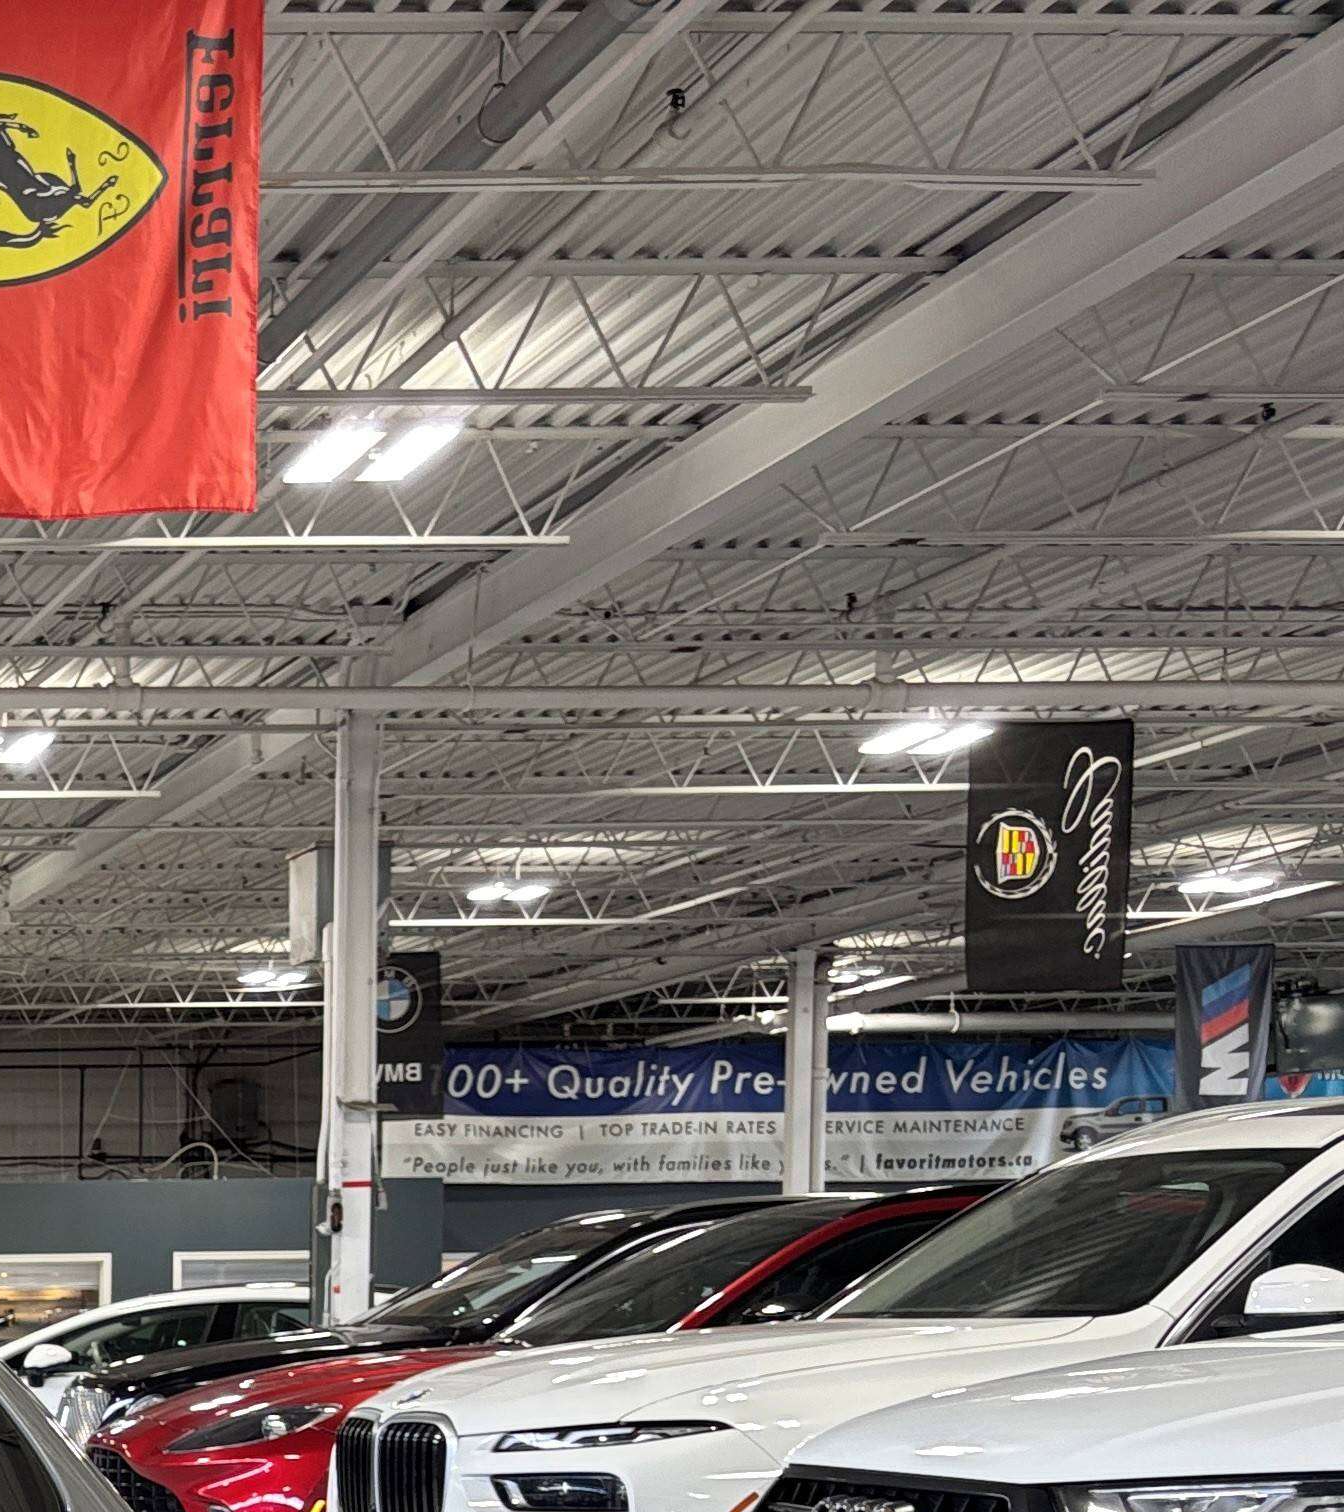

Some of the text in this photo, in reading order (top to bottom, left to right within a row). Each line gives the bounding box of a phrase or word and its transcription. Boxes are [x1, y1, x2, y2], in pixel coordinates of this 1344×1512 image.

[446, 1063, 530, 1099] 00+
[547, 1060, 695, 1106] Quality
[945, 1052, 1109, 1094] Vehicles
[414, 1122, 564, 1139] EASY FINANCING
[599, 1120, 777, 1137] TOP TRADE-IN RATES
[825, 1117, 1025, 1134] ERVICE MAINTENANCE
[483, 1157, 517, 1177] just
[525, 1157, 559, 1174] like
[565, 1161, 604, 1178] you,
[613, 1155, 651, 1172] with
[658, 1154, 732, 1173] families
[739, 1153, 771, 1171] like
[875, 1152, 1033, 1171] favoritmotors.ca
